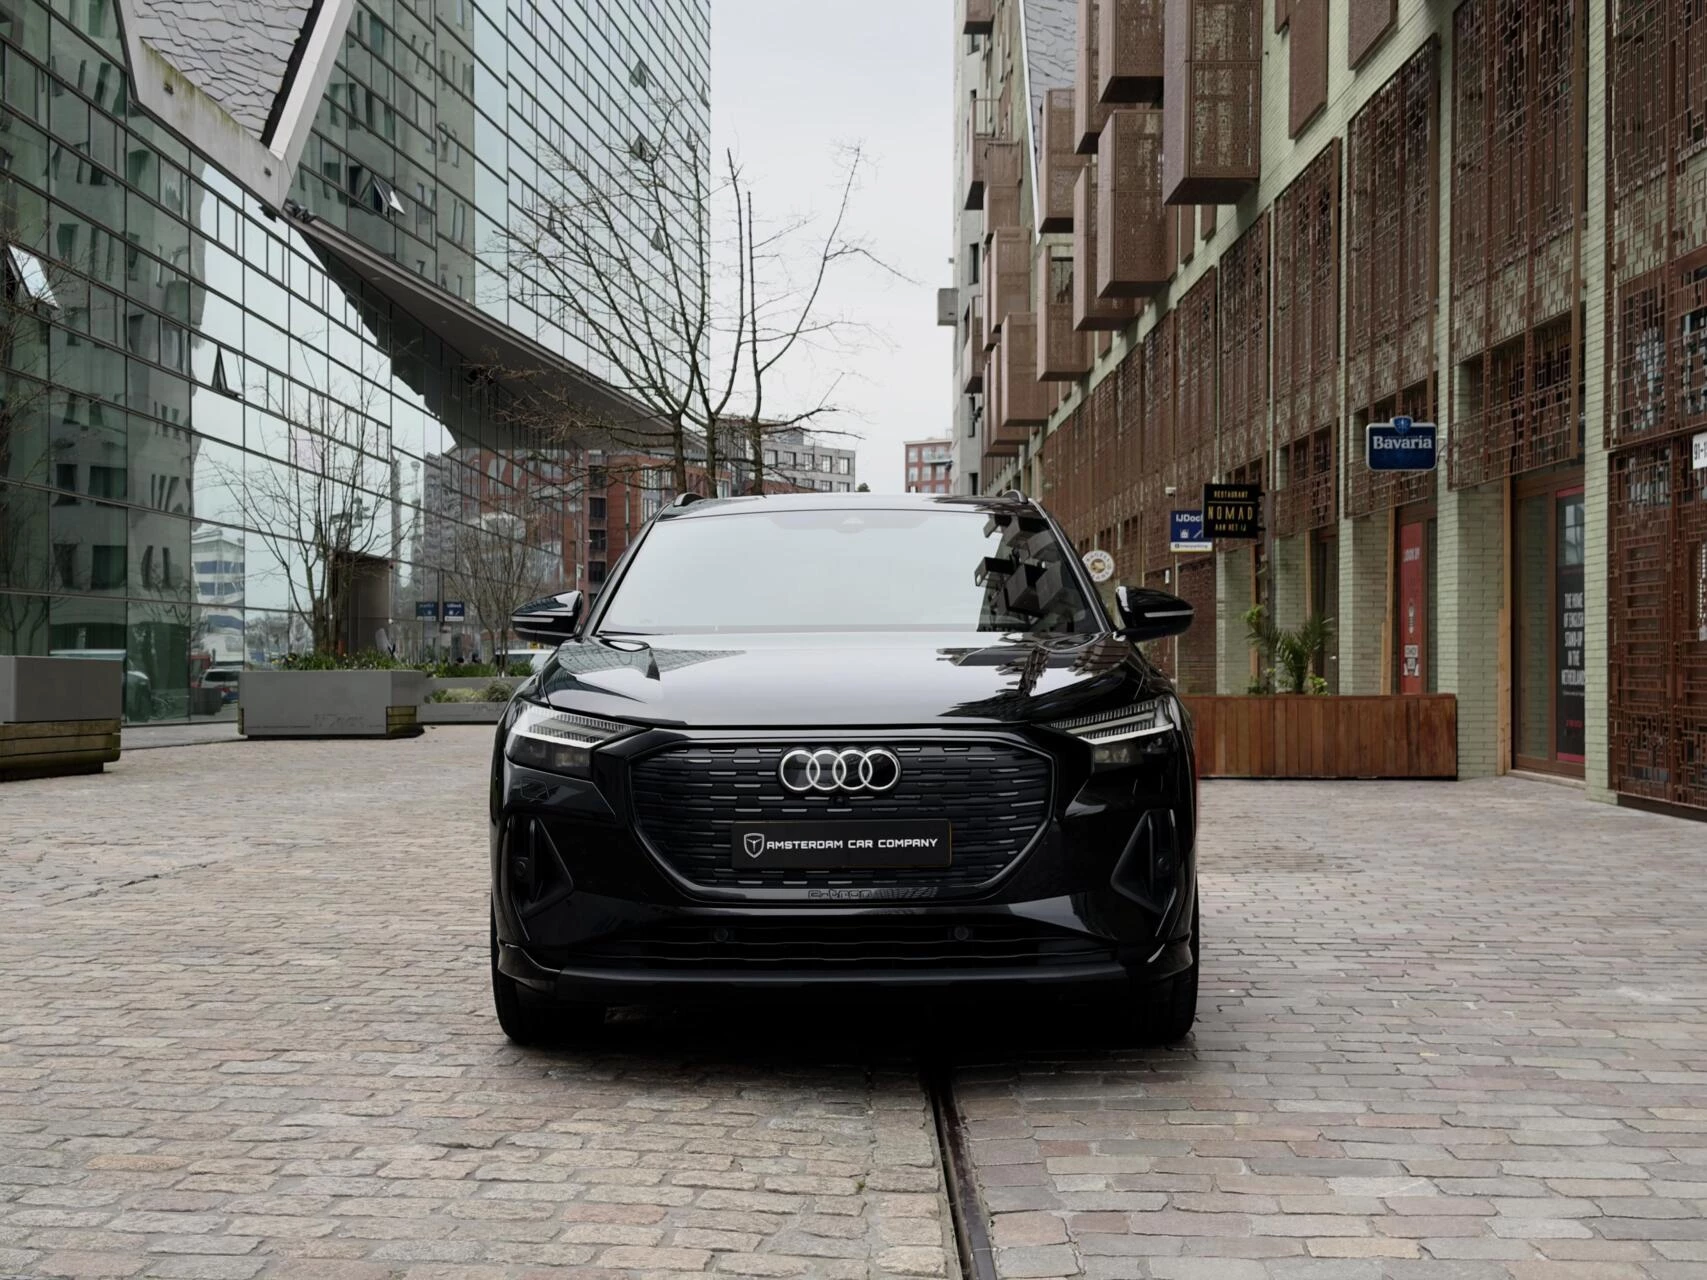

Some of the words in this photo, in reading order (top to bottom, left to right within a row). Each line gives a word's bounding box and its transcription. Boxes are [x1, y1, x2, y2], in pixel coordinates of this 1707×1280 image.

[1373, 435, 1432, 449] Bavaria
[1214, 490, 1249, 498] RESTAURANT
[1208, 506, 1253, 520] NOMAD
[1228, 523, 1239, 531] HET
[766, 840, 843, 850] AMSTERDAM
[847, 839, 873, 849] CAR
[878, 838, 938, 848] COMPANY
